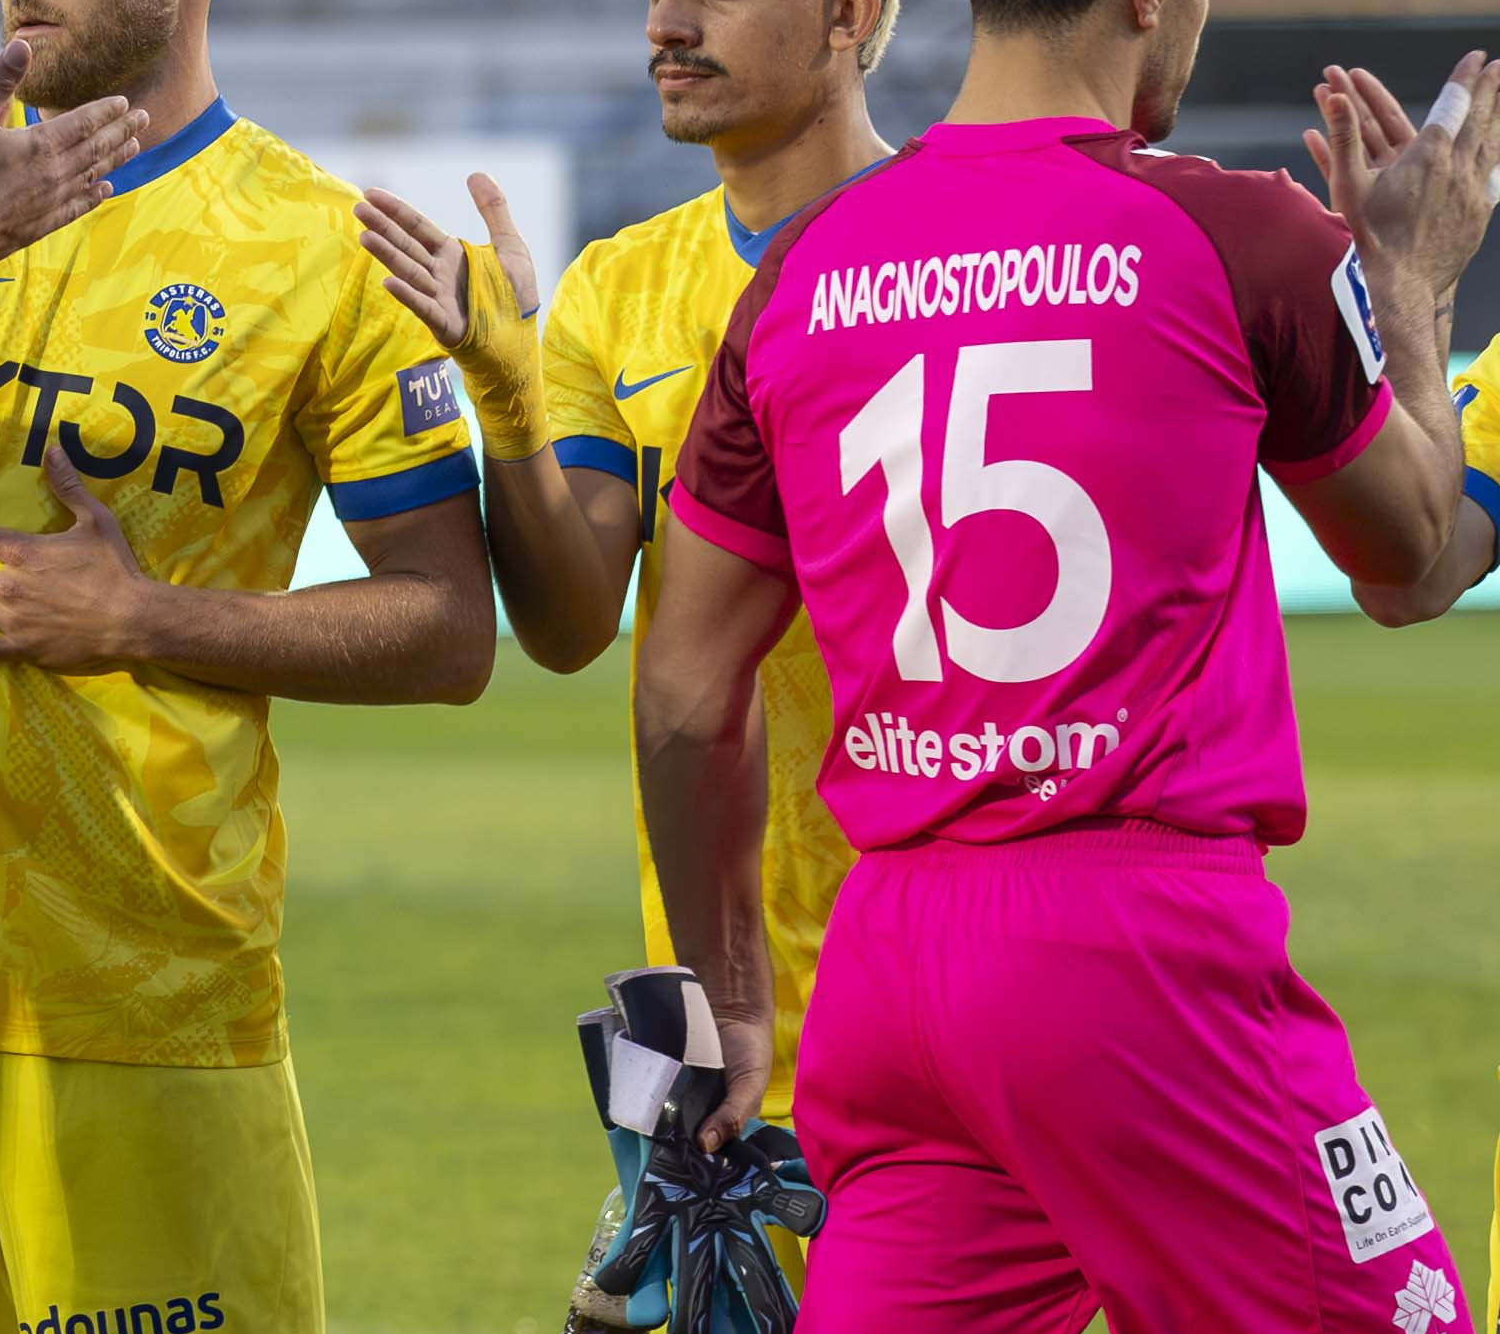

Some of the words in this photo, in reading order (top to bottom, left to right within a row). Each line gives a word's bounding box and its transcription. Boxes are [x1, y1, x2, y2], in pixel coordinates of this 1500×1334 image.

[160, 285, 220, 311] ASTERAS
[806, 242, 1143, 336] ANAGNOSTOPOULOS
[152, 335, 192, 360] TRIPOLIS
[839, 339, 1113, 684] 15
[845, 712, 943, 779] elite
[948, 721, 1120, 781] stom
[1356, 1234, 1374, 1250] Life
[1375, 1229, 1388, 1243] On
